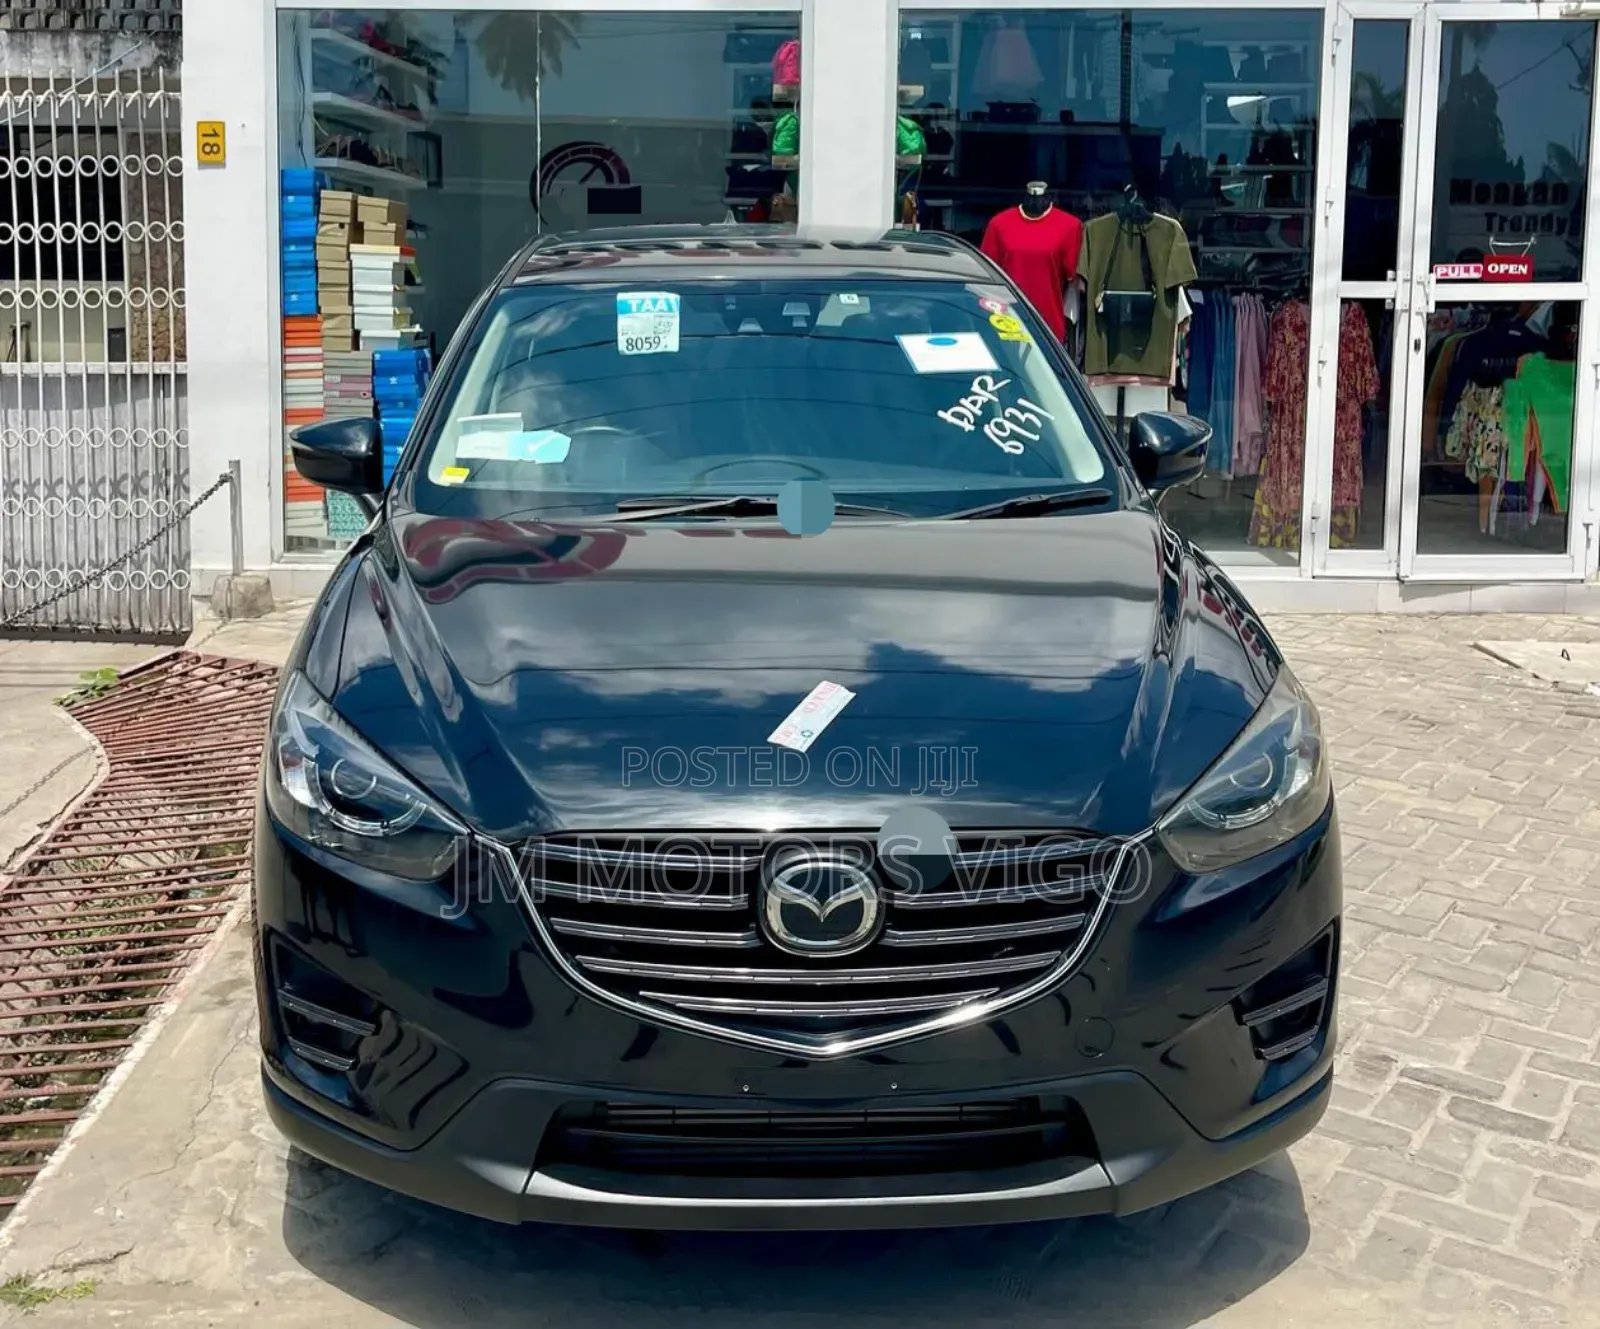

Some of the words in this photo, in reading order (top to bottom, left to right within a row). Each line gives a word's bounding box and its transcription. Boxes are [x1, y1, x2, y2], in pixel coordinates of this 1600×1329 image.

[201, 127, 221, 156] 18
[1484, 212, 1568, 237] Trendy
[1436, 265, 1481, 278] PULL
[1487, 263, 1528, 275] OPEN
[629, 297, 675, 313] TAA
[625, 335, 661, 352] 8059
[983, 398, 1055, 455] 6931
